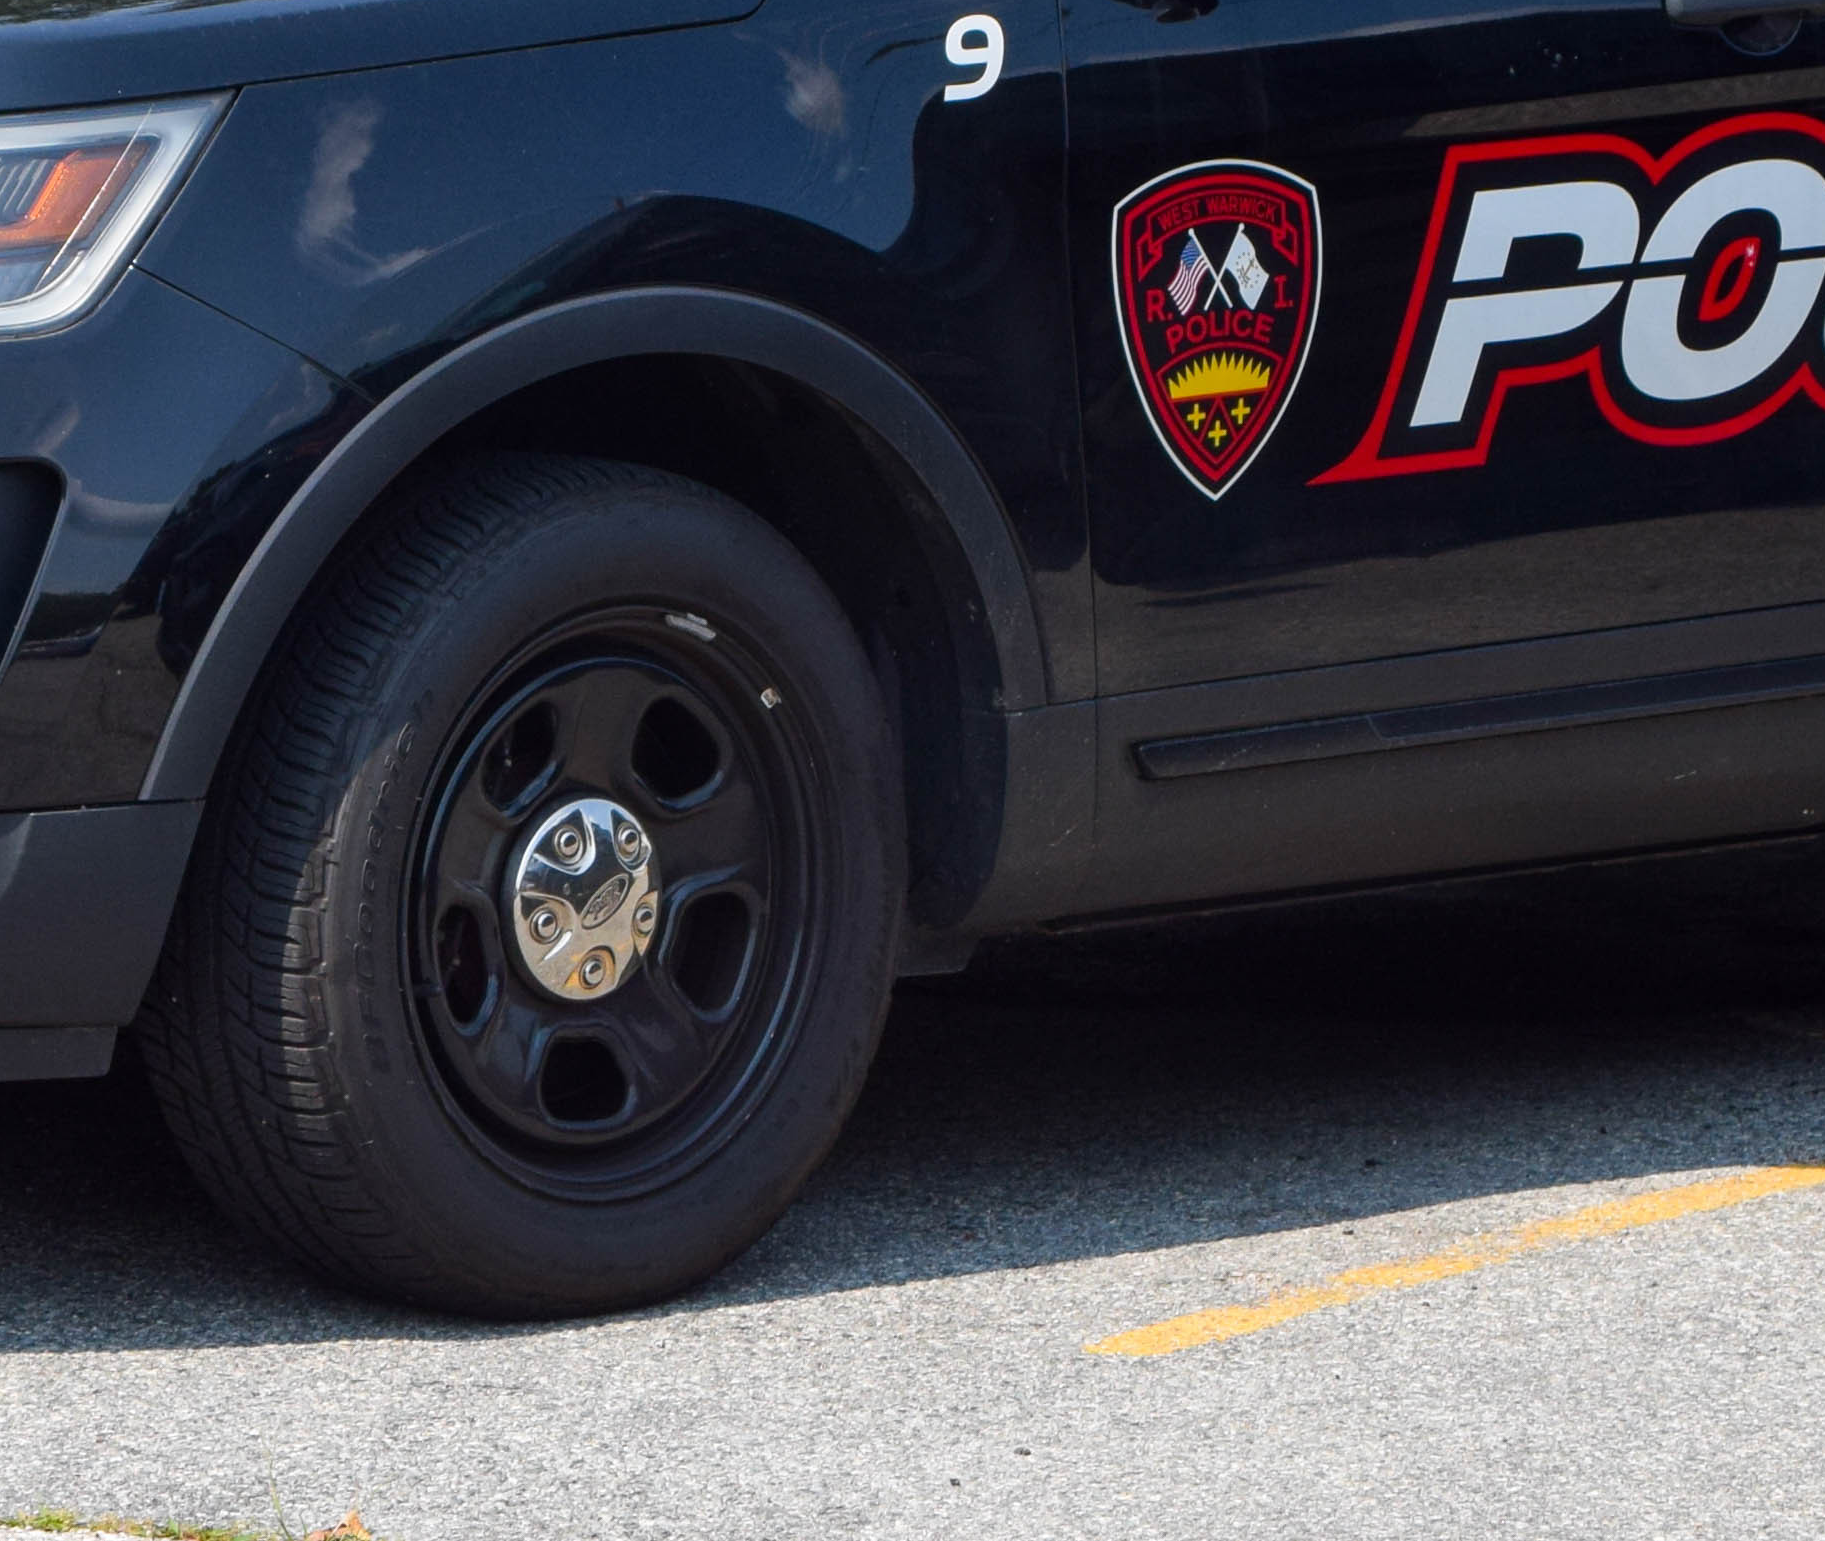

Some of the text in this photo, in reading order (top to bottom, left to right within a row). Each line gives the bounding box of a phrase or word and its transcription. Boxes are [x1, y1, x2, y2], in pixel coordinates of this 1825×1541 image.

[943, 13, 1006, 102] 9
[1157, 196, 1277, 231] WEST WARWICK
[1145, 275, 1294, 323] R. I.
[1165, 309, 1274, 355] POLICE
